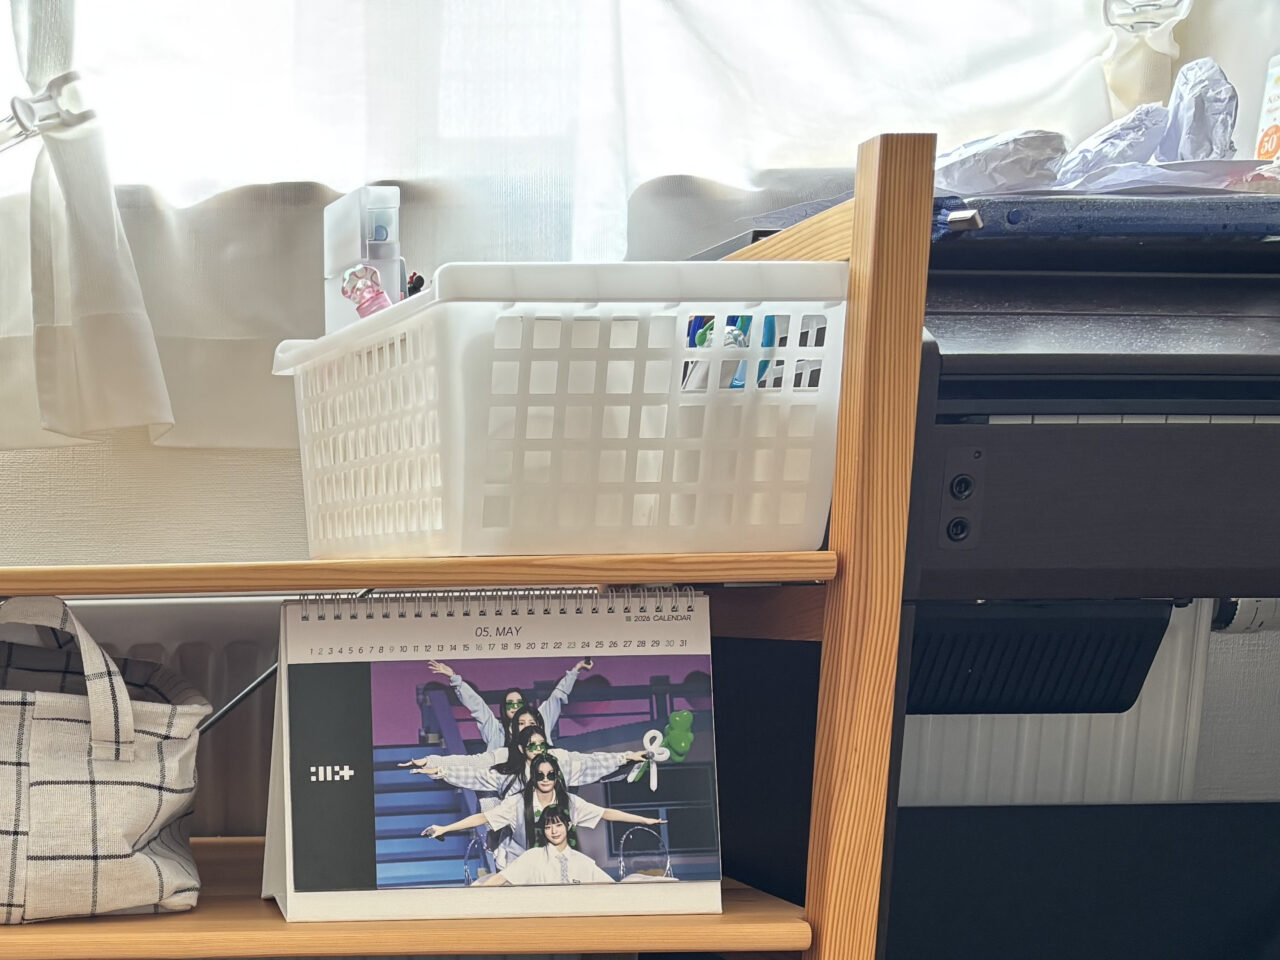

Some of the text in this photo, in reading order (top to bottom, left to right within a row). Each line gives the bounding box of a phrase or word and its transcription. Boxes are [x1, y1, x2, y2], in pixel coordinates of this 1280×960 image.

[653, 614, 692, 622] CALENDAR
[475, 626, 522, 638] 05. MAY
